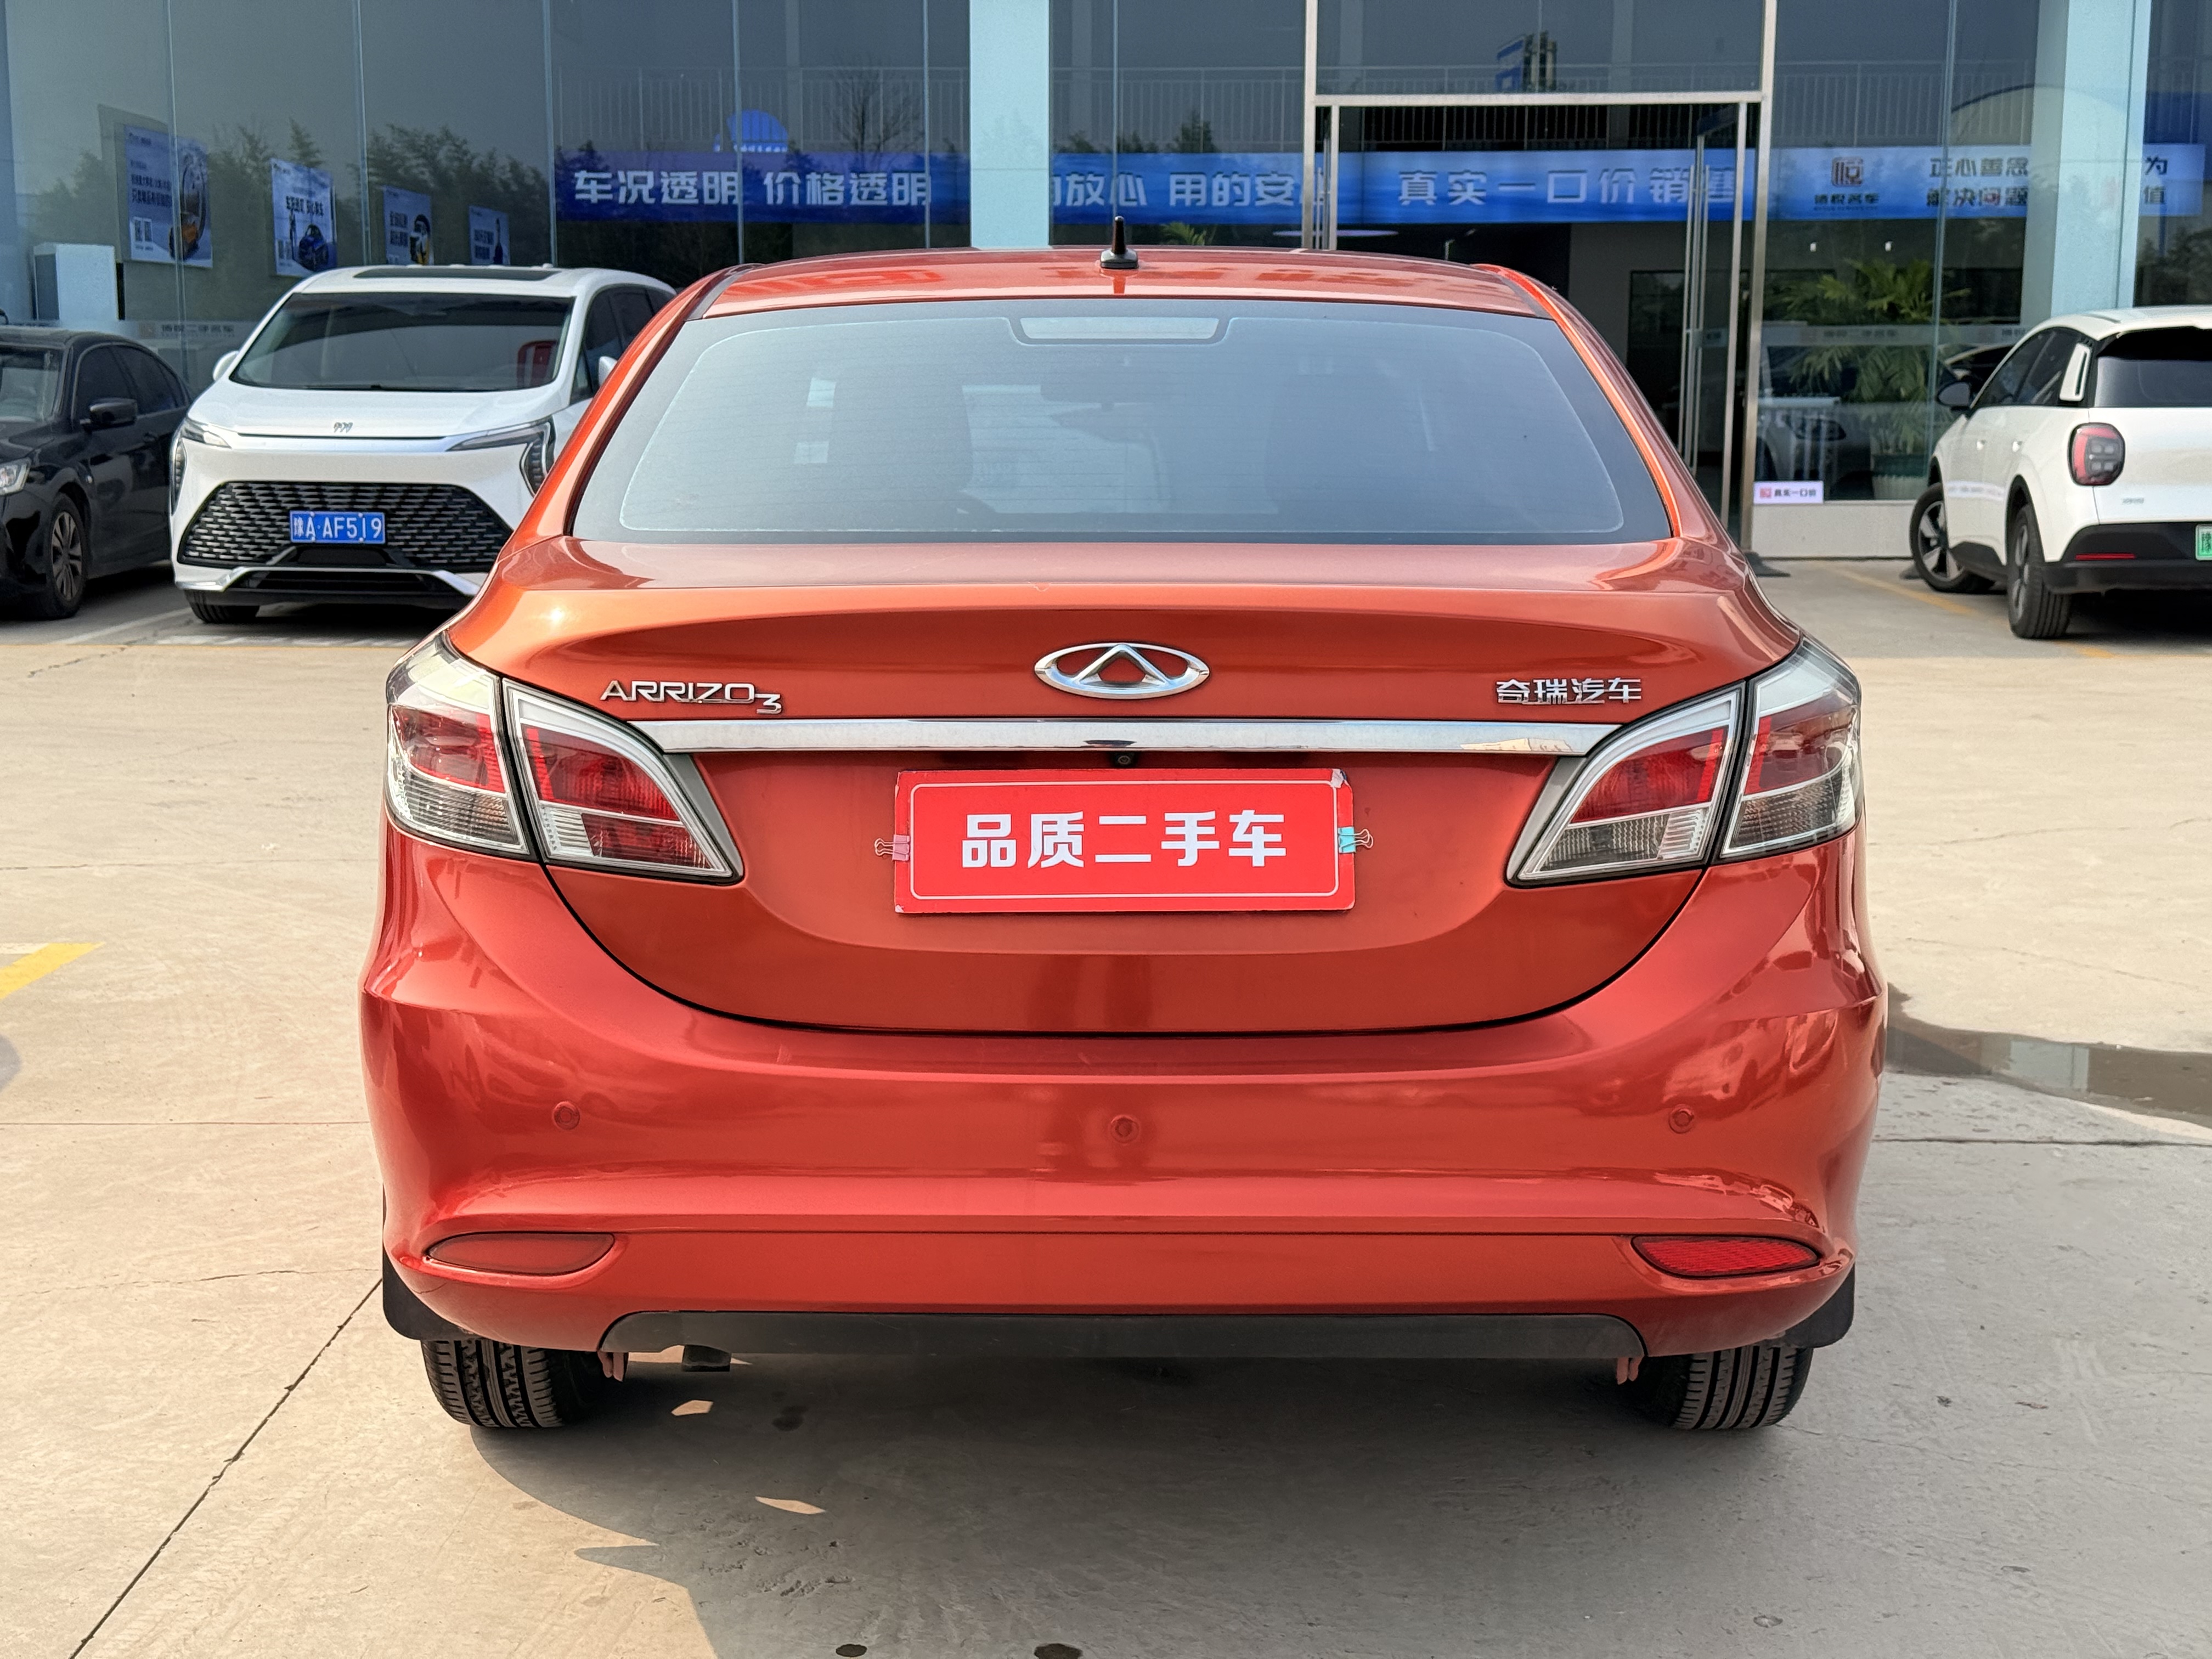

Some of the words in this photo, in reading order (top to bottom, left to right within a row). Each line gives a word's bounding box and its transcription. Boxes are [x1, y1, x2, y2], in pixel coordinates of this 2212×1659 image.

[574, 170, 740, 206] 车况透明
[763, 171, 932, 207] 价格透明
[1496, 678, 1642, 704] 奇瑞汽车
[961, 809, 1287, 869] 品质二手车
